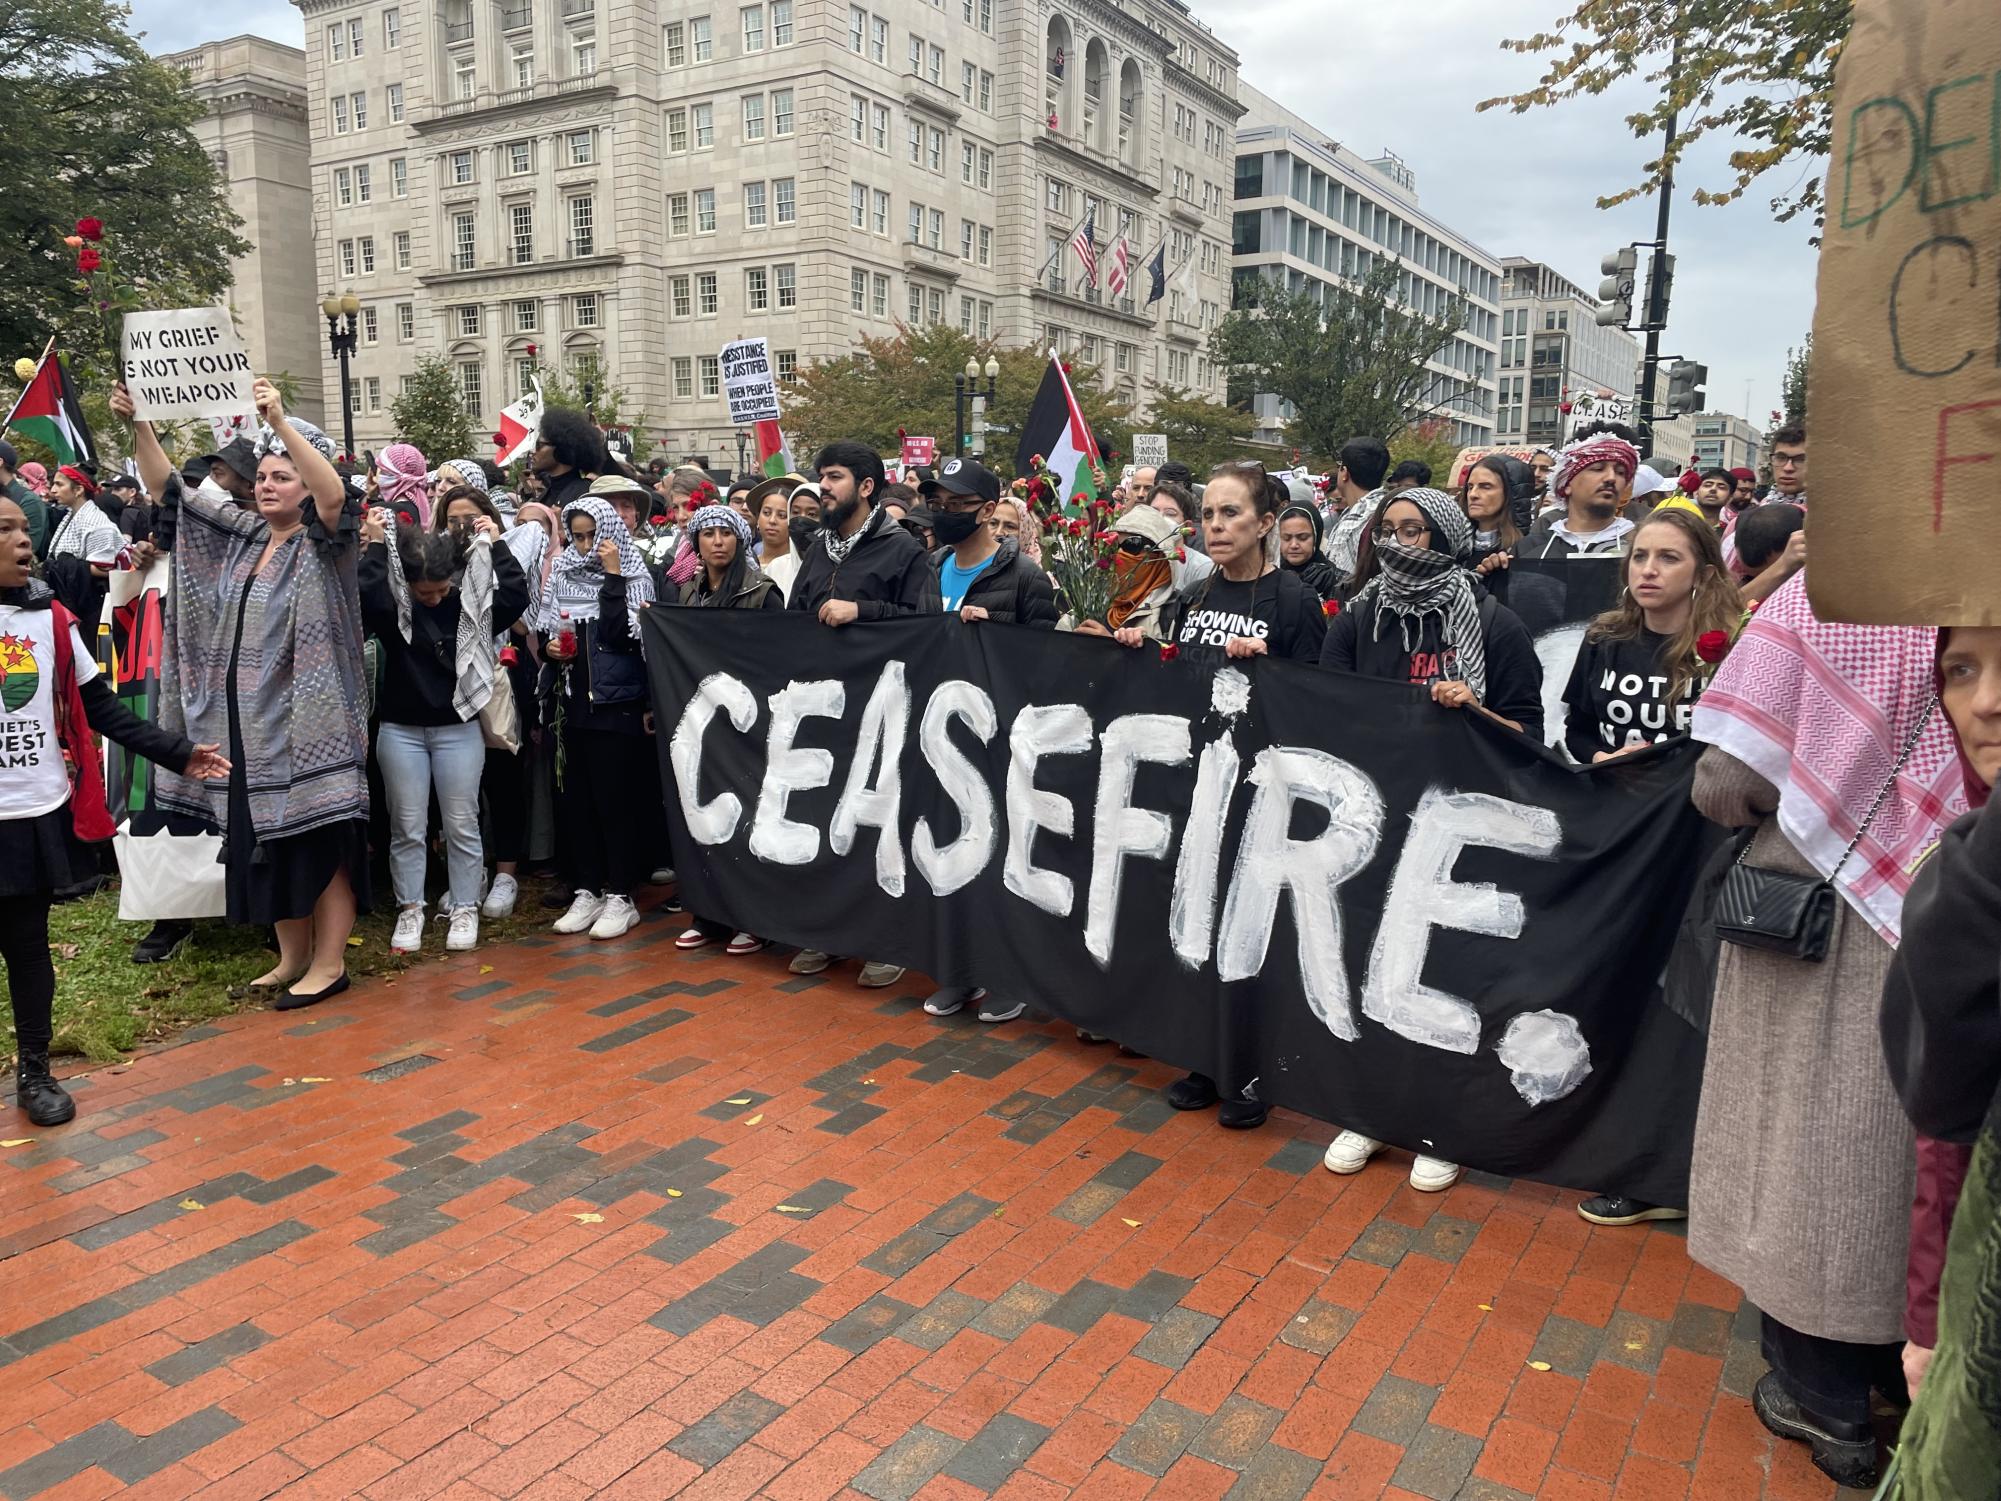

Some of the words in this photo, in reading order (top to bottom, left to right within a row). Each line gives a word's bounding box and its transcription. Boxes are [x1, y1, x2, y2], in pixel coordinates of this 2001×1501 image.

[1841, 69, 2001, 229] DE
[130, 331, 152, 350] MY
[159, 326, 220, 348] GRIEF
[140, 358, 179, 378] NOT
[184, 353, 250, 375] YOUR
[724, 365, 731, 379] IS
[732, 359, 768, 377] JUSTIFIED
[141, 382, 238, 405] WEAPON
[728, 387, 745, 399] WHEN
[746, 382, 773, 398] PEOPLE
[730, 401, 741, 412] ARE
[608, 440, 620, 451] NO
[1139, 436, 1159, 446] STOP
[1135, 446, 1166, 456] FUNDING
[1135, 456, 1167, 466] GENOCIDE
[1184, 610, 1269, 639] SHOWING
[1180, 627, 1198, 643] UP
[1600, 668, 1668, 698] NOT
